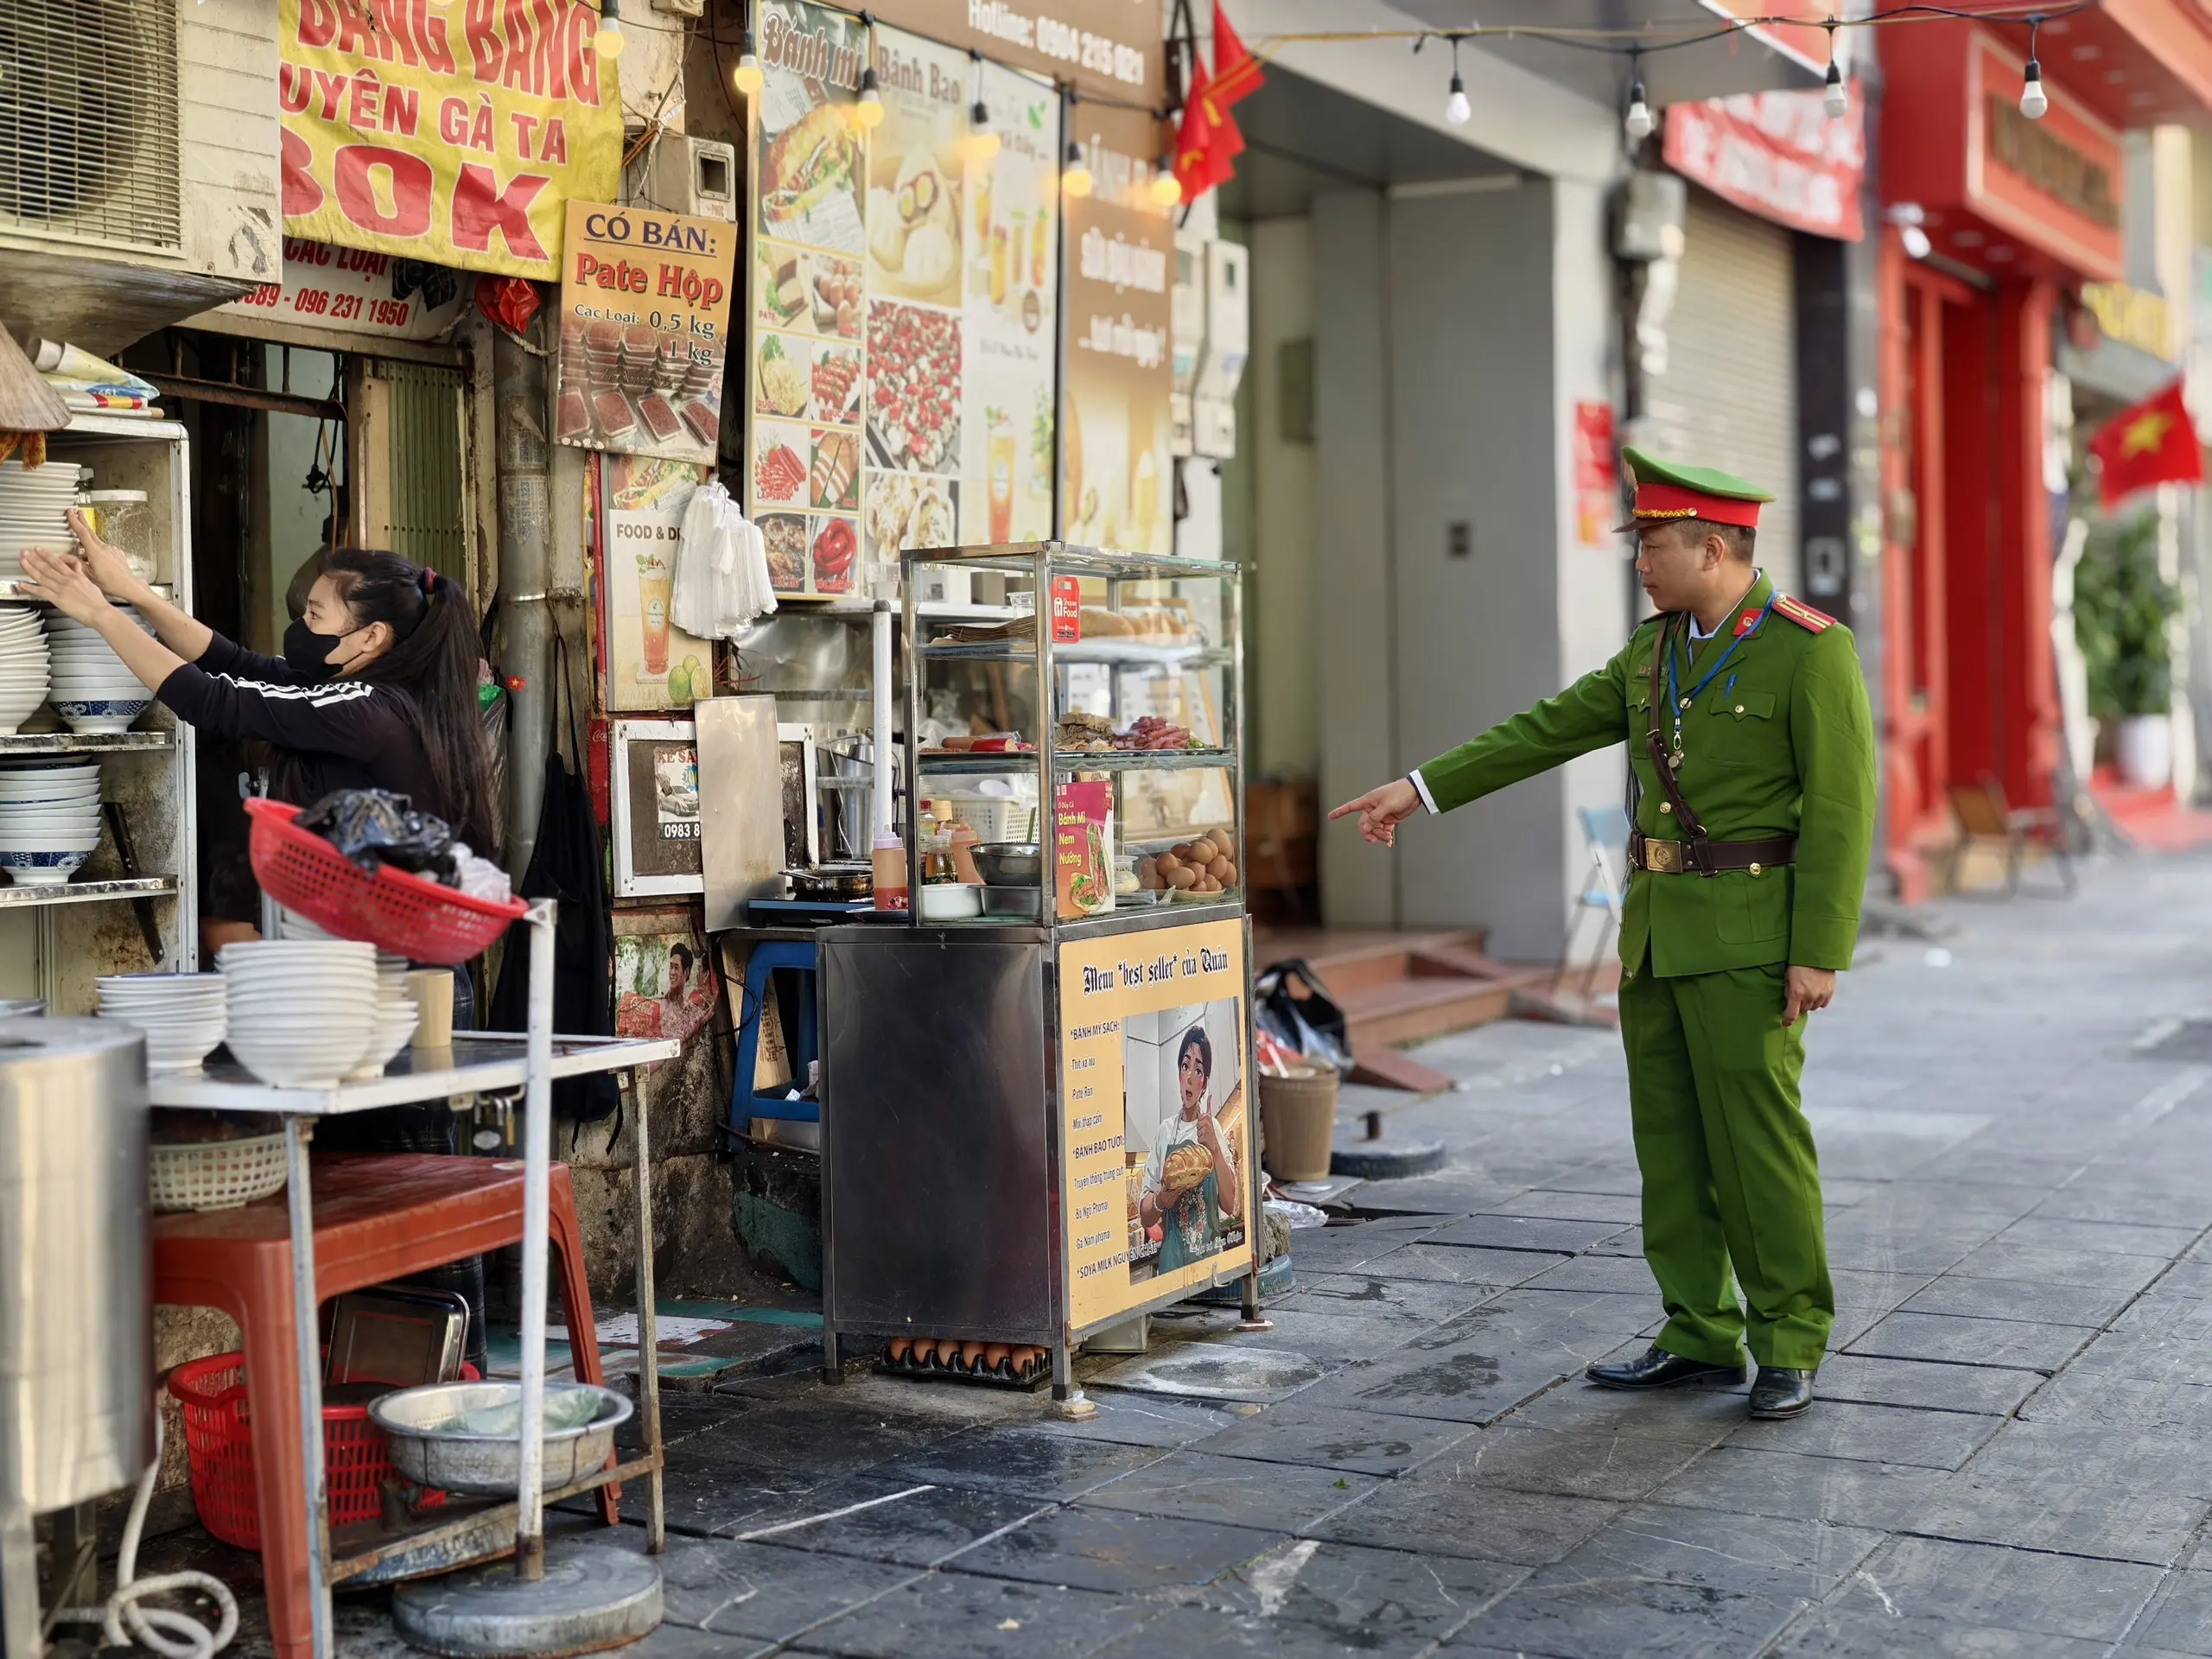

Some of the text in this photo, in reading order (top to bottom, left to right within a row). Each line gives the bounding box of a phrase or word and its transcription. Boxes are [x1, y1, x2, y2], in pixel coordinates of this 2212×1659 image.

[440, 92, 494, 155] GÀ
[512, 113, 567, 164] TA
[586, 211, 716, 254] CÓ BÁN:
[575, 252, 723, 309] Pate Hộp
[295, 288, 329, 315] 096
[330, 293, 363, 320] 231
[369, 298, 410, 327] 1950
[575, 304, 601, 318] Các
[649, 310, 681, 332] 0,5
[690, 315, 715, 340] kg
[670, 341, 714, 366] 1 kg
[617, 524, 652, 540] FOOD
[656, 527, 664, 540] &
[1063, 607, 1077, 618] Food
[664, 823, 690, 838] 0983
[1058, 812, 1076, 825] Bánh
[1058, 832, 1074, 845] Nem
[1084, 966, 1113, 995] Menu
[1097, 1256, 1112, 1272] MILK
